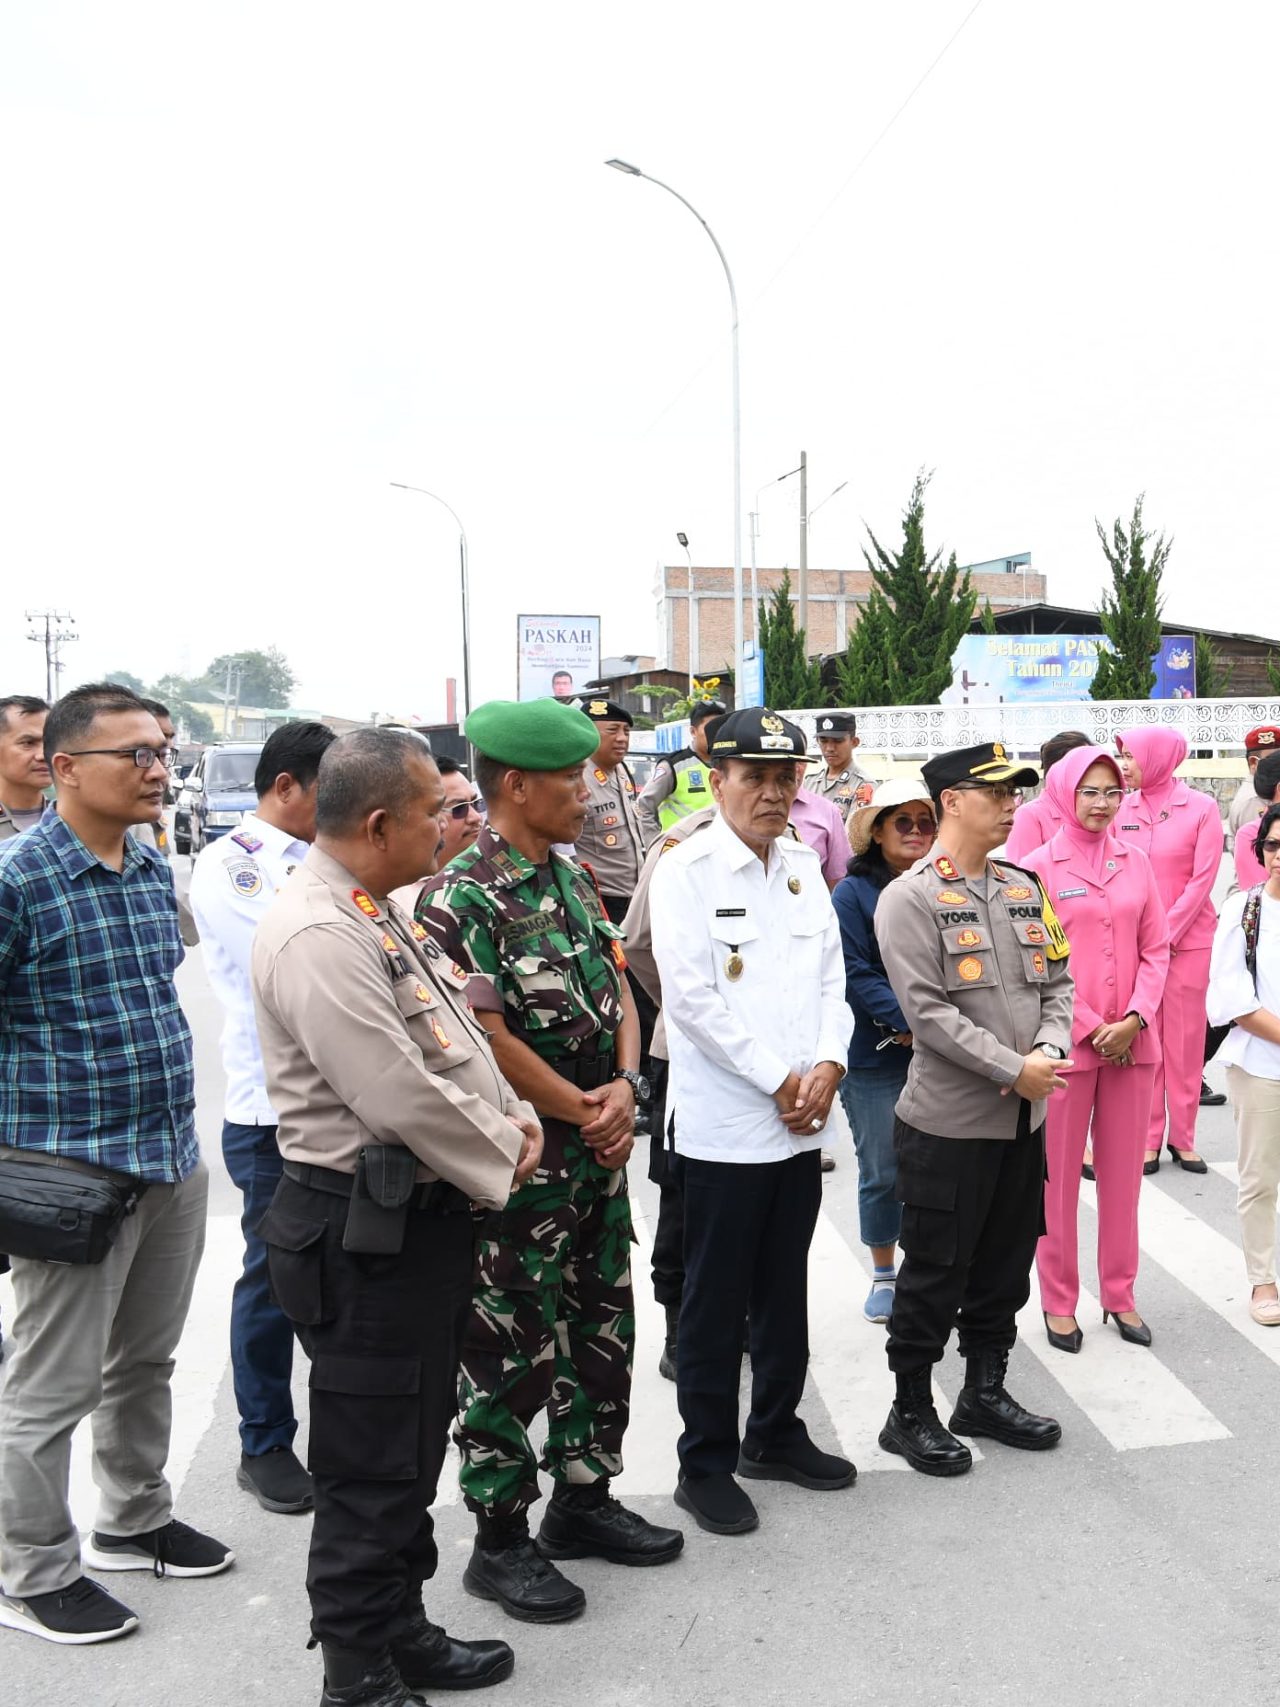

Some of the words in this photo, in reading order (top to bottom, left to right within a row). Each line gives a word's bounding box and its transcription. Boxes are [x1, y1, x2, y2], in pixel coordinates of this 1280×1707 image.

[525, 629, 592, 643] PASKAH
[987, 639, 1059, 657] Selamat
[1065, 639, 1116, 657] PASK
[1008, 660, 1064, 678] Tahun
[1069, 660, 1099, 678] 20
[594, 801, 616, 813] TITO
[940, 911, 979, 925] YOGIE
